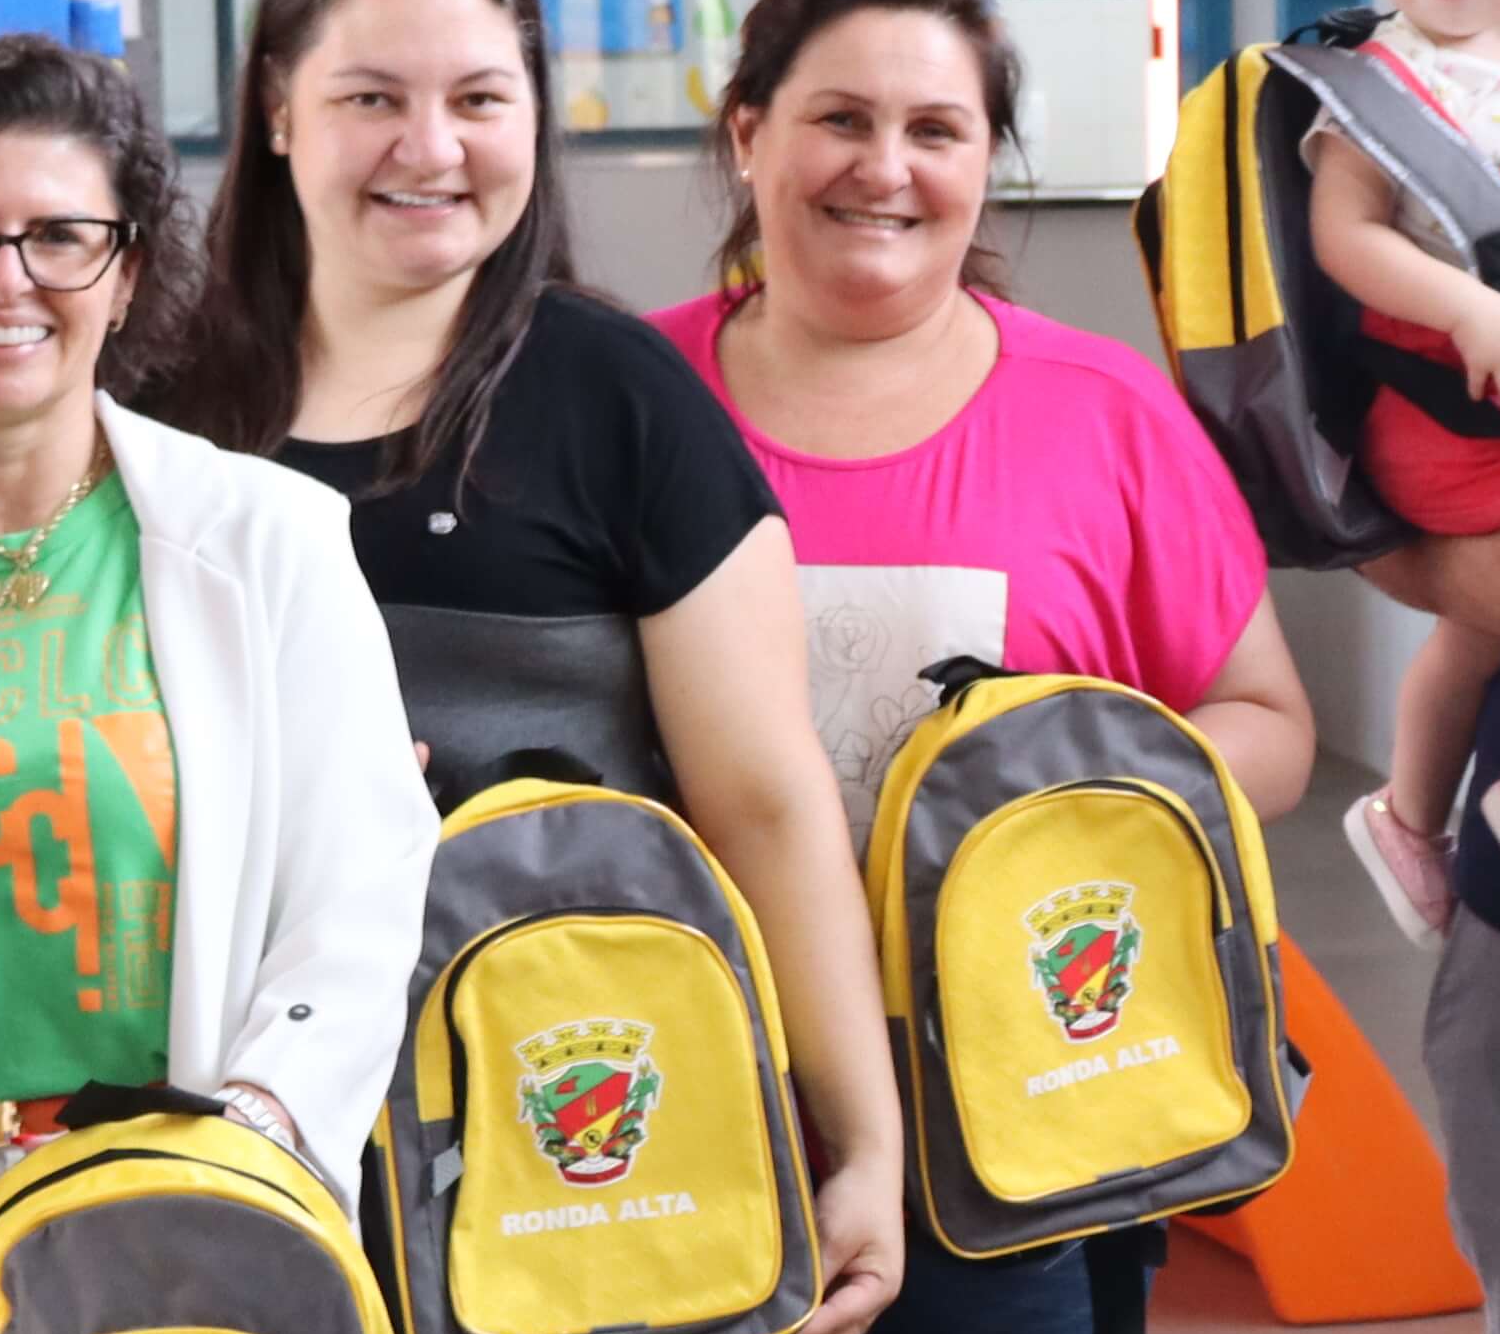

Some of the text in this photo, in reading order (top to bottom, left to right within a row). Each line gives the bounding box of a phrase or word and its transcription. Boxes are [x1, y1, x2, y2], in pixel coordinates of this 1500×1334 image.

[1027, 1035, 1181, 1097] RONDA ALTA
[501, 1192, 697, 1236] RONDA ALTA
